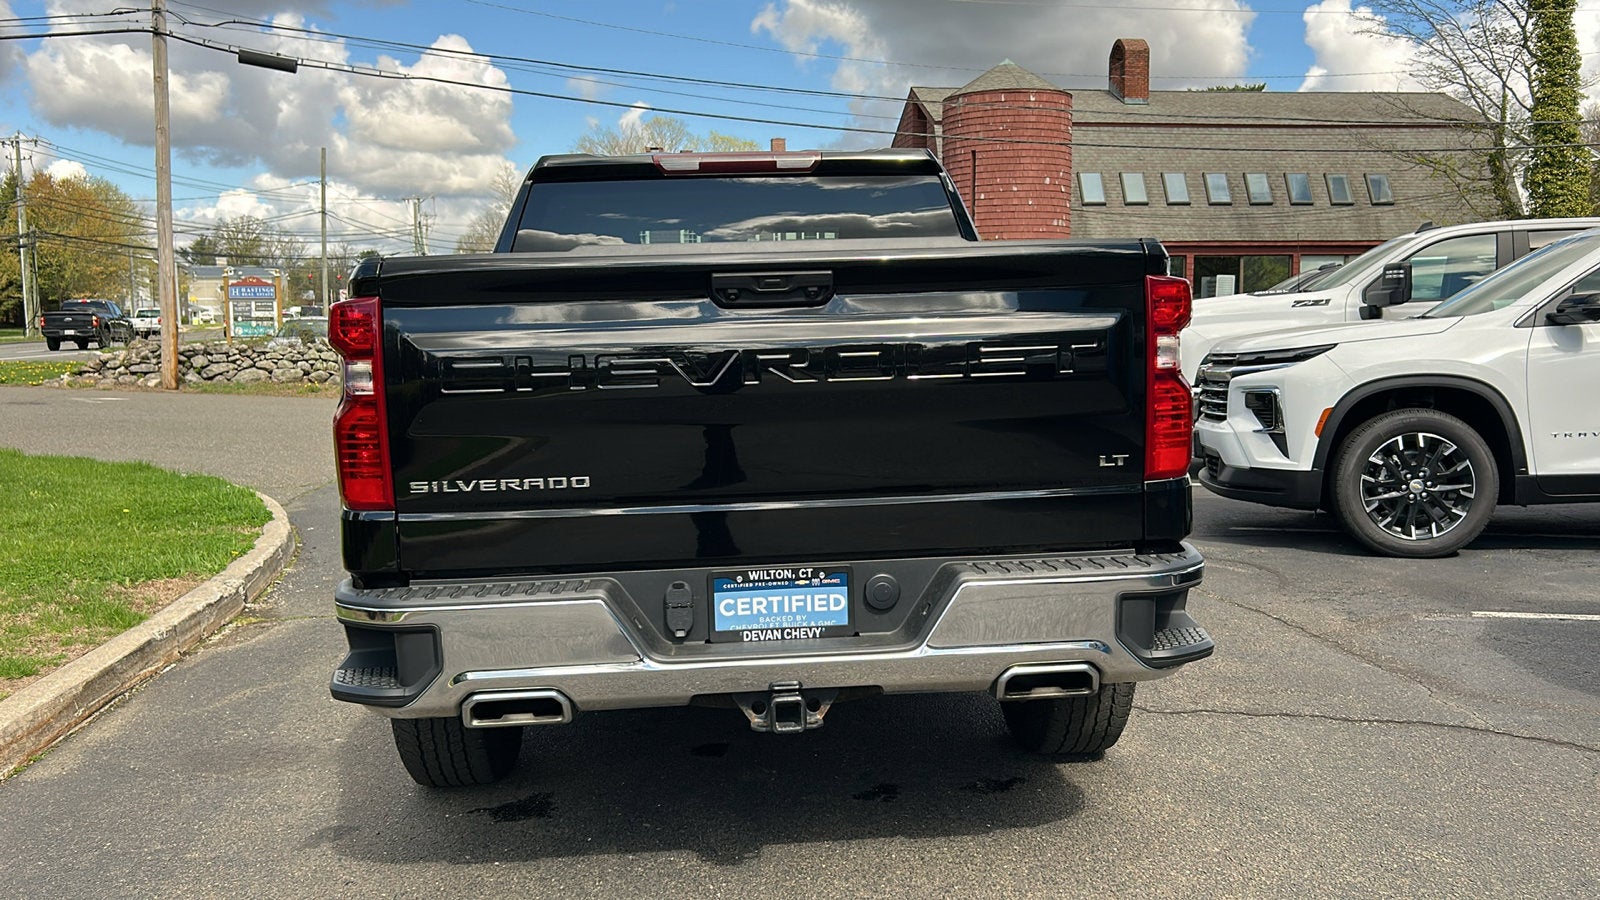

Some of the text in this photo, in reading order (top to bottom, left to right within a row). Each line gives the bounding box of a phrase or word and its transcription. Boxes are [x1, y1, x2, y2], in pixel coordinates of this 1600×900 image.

[438, 342, 1099, 394] CHEVROLET
[1099, 454, 1130, 467] LT
[409, 476, 591, 494] SILVERADO
[748, 568, 814, 581] WILTON, CT
[719, 594, 846, 616] CERTIFIED
[759, 614, 807, 623] BACKED BY
[730, 622, 781, 630] CHEVROLET
[743, 627, 822, 642] DEVAN CHEVY
